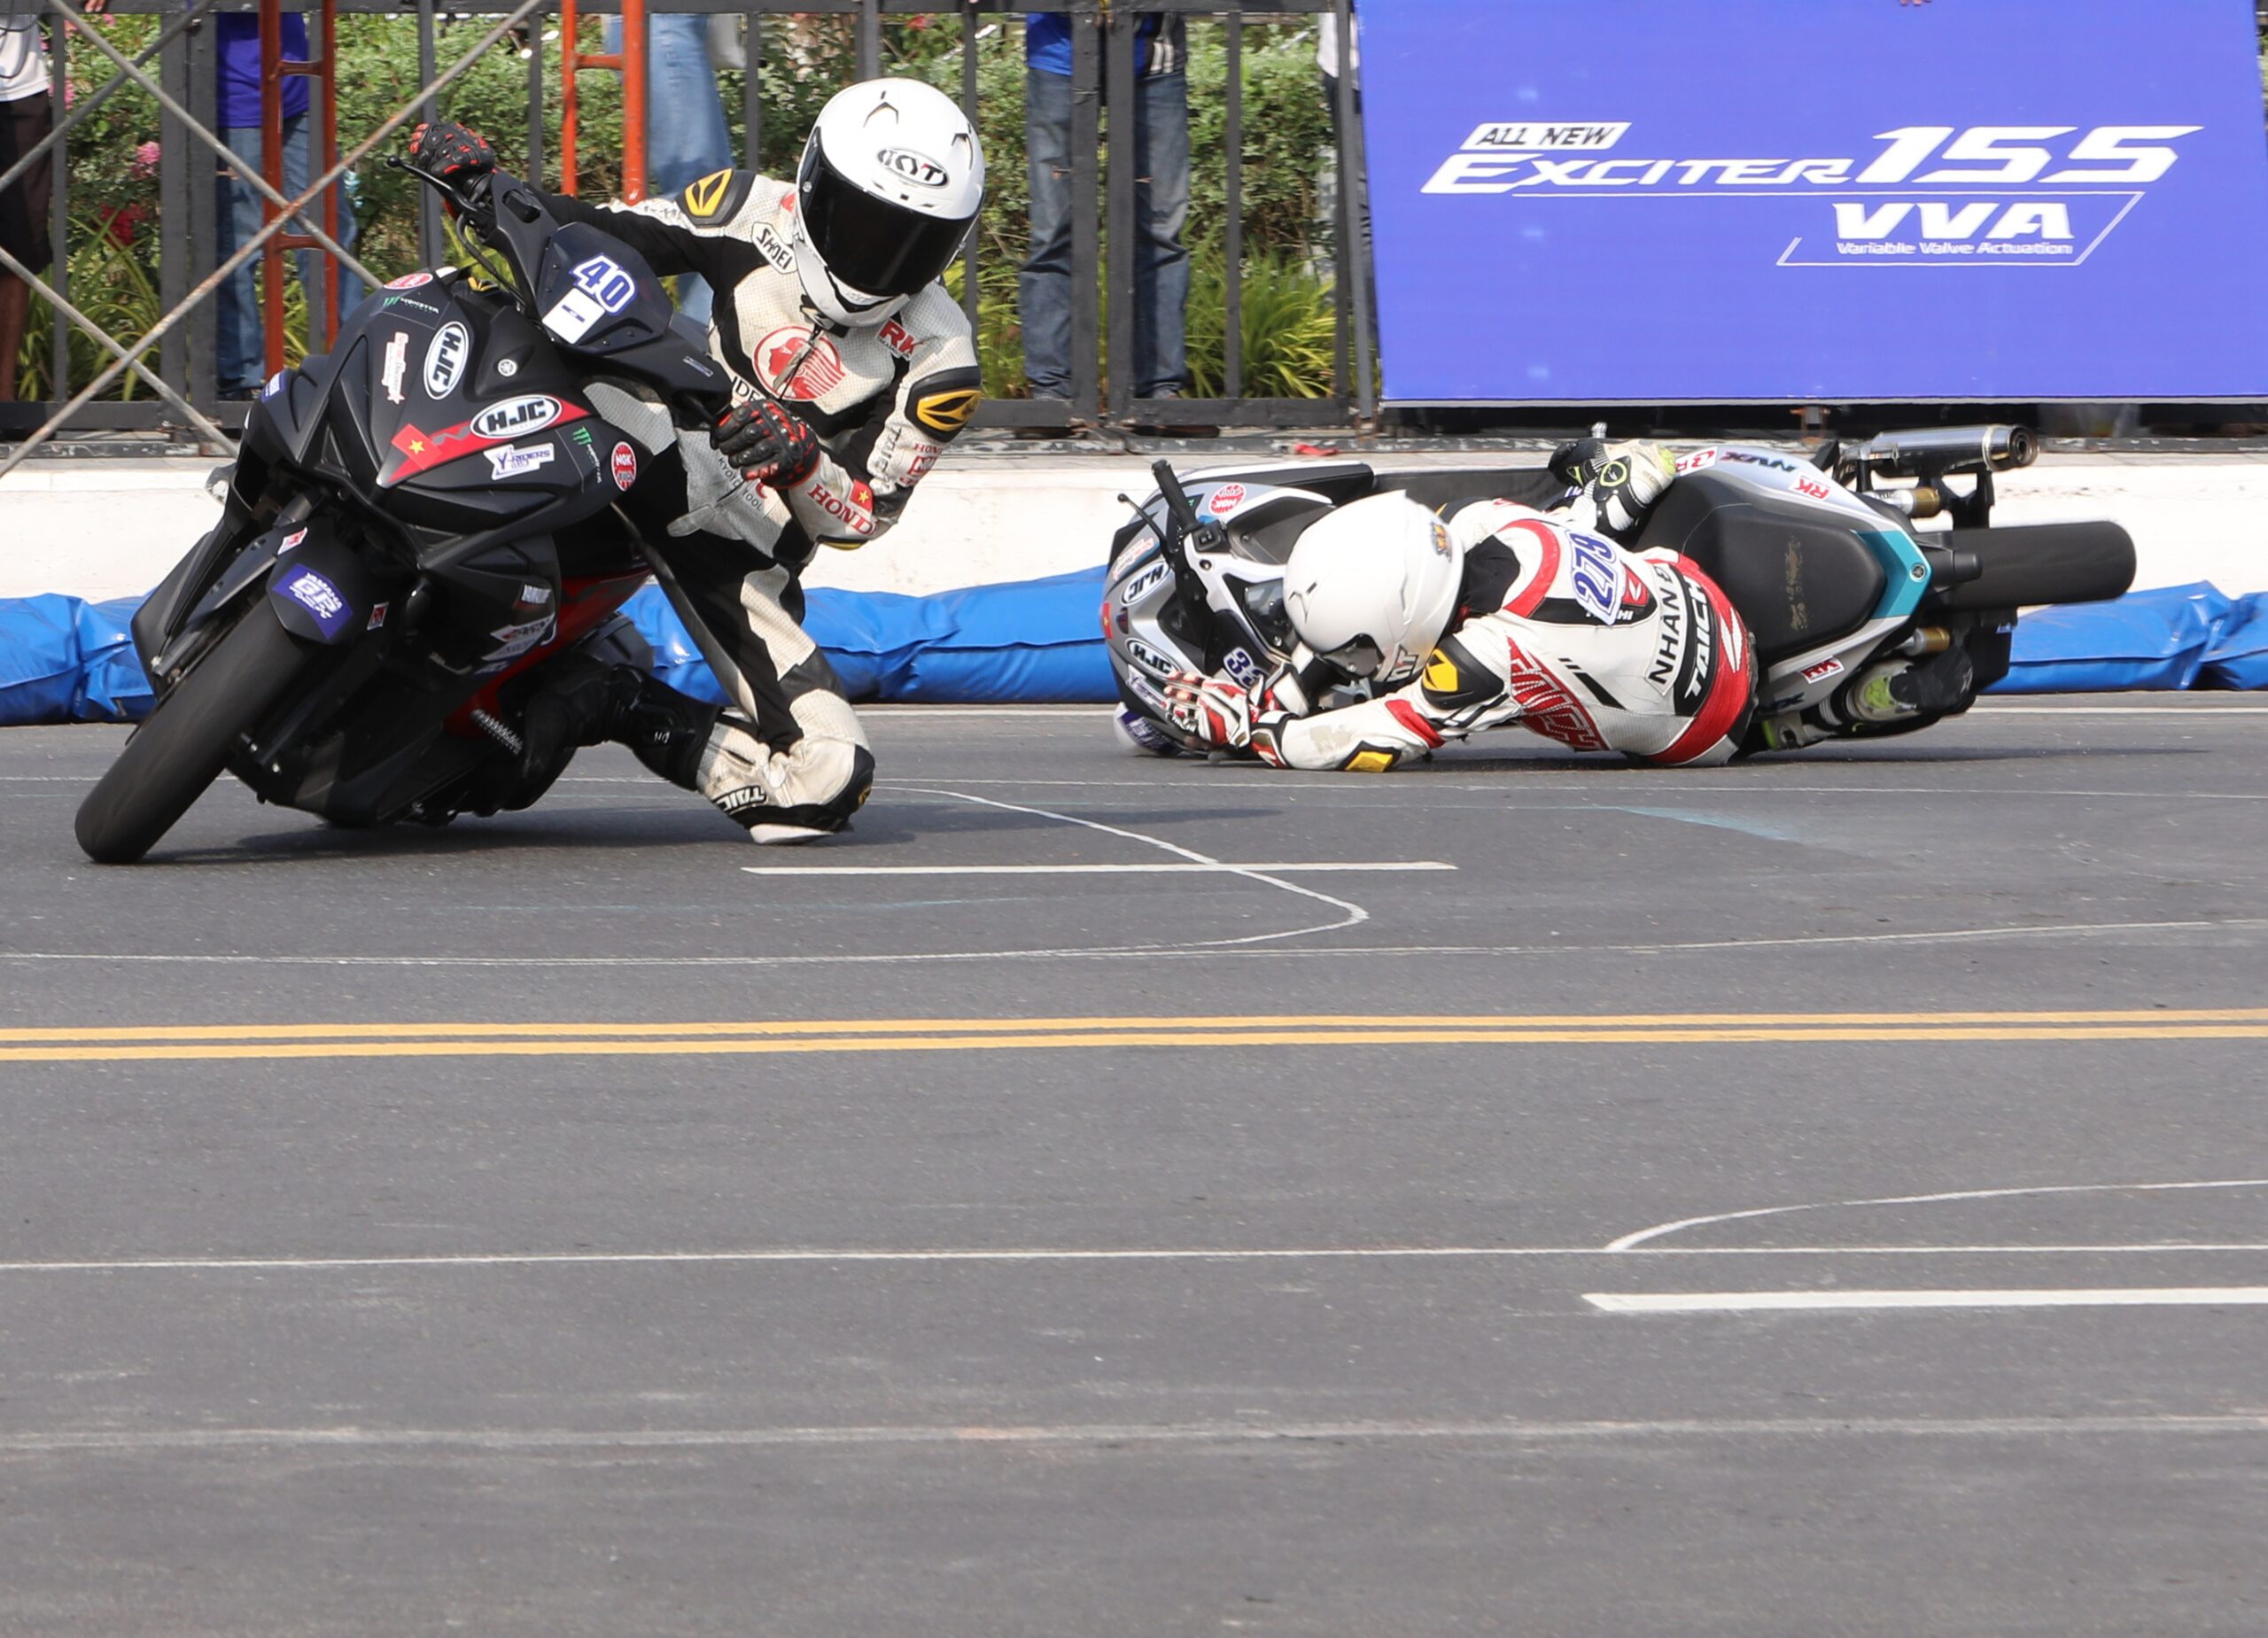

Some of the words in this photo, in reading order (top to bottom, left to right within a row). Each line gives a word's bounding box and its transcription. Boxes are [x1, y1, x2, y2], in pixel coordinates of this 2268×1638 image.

[1476, 127, 1526, 145] ALL
[1539, 127, 1615, 145] NEW
[1420, 153, 1855, 193] EXCITER
[1855, 126, 2205, 182] 155
[1832, 203, 2074, 238] VVA
[756, 228, 793, 269] SHOEI
[1837, 242, 1916, 254] Variable
[1919, 242, 1975, 254] Valve
[1977, 242, 2073, 254] Actuation
[574, 256, 634, 312] 40
[879, 320, 924, 355] RK
[432, 331, 462, 386] HJC
[486, 400, 547, 432] HJC
[615, 454, 633, 467] NGK
[718, 458, 742, 487] KYOTO
[1719, 451, 1798, 472] NVX
[1796, 478, 1830, 499] RK
[807, 484, 879, 535] HOND
[1128, 563, 1164, 600] HJC
[1569, 532, 1614, 609] 279
[1134, 644, 1172, 674] HJC
[1800, 659, 1839, 679] RK
